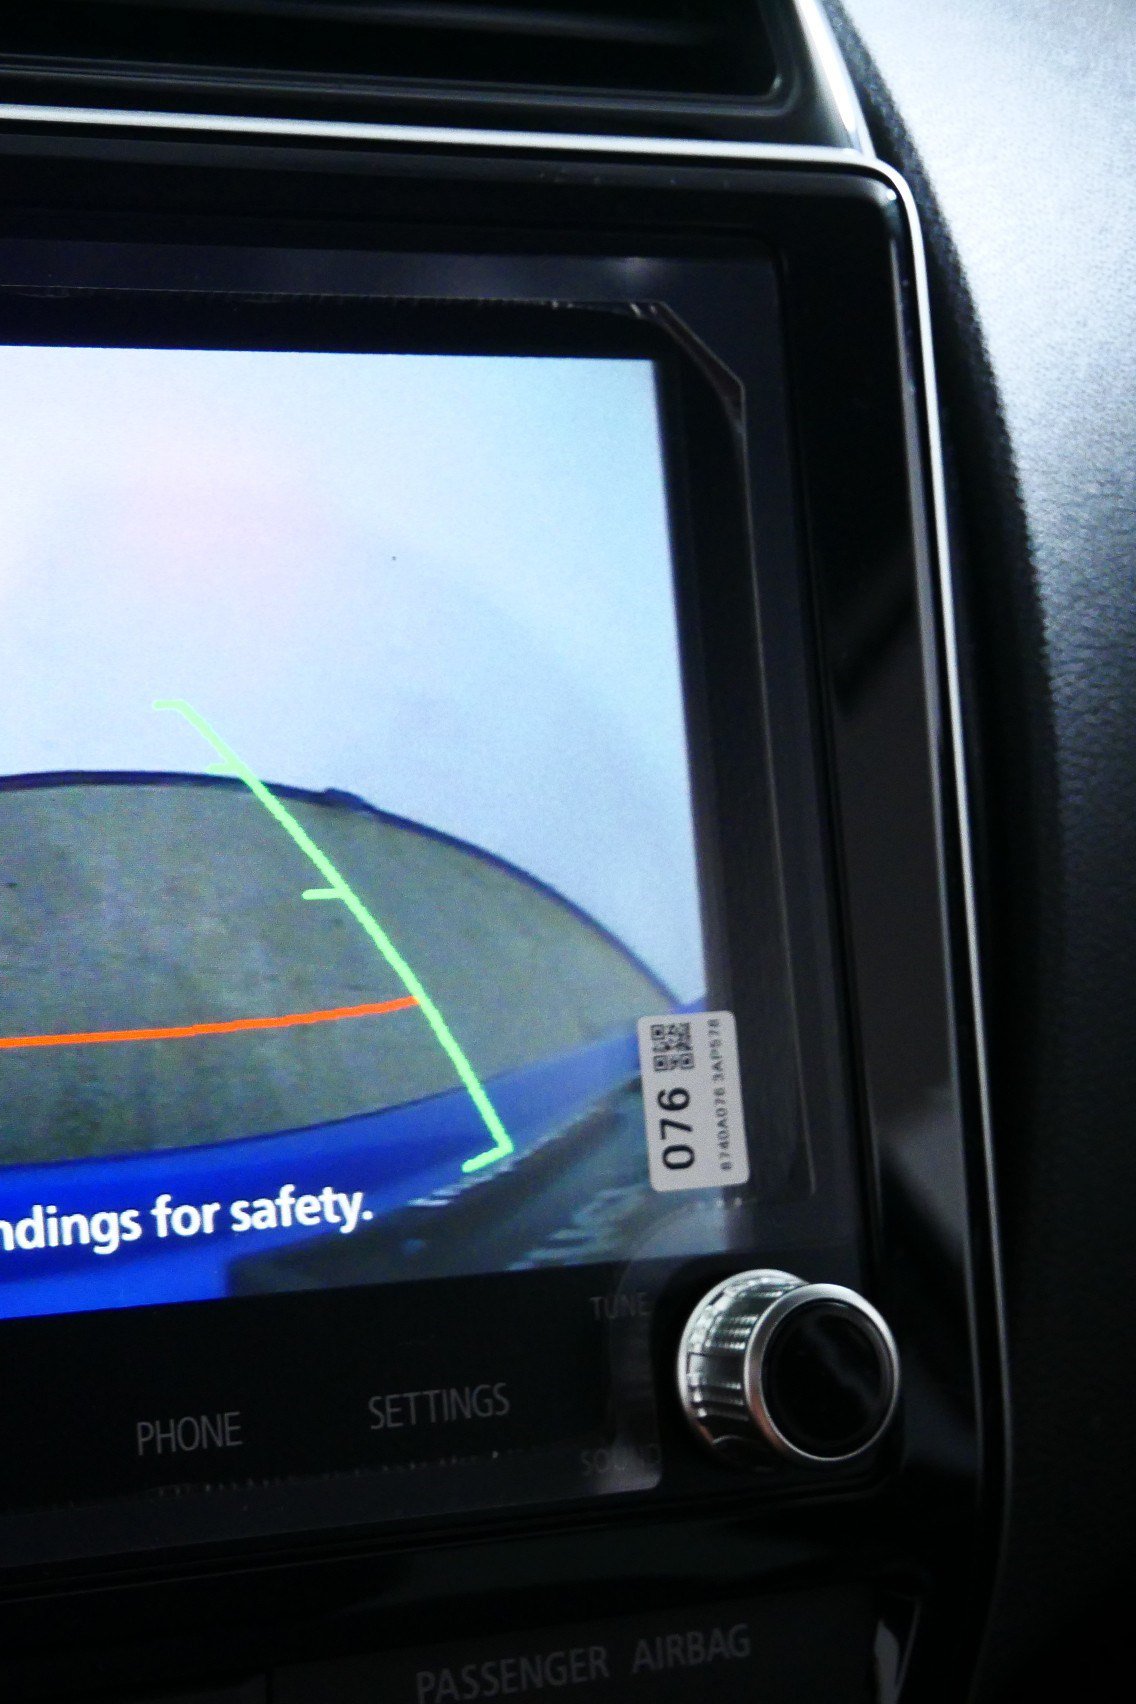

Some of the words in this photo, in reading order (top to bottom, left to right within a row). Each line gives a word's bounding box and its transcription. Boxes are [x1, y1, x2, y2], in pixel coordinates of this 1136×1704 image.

[657, 1088, 694, 1170] 076
[151, 1194, 218, 1239] for
[230, 1186, 374, 1234] safety.
[590, 1293, 650, 1322] TUNE
[367, 1384, 510, 1429] SETTINGS
[136, 1411, 242, 1455] PHONE
[416, 1646, 610, 1704] PASSENGER
[632, 1624, 752, 1670] AIRBAG
